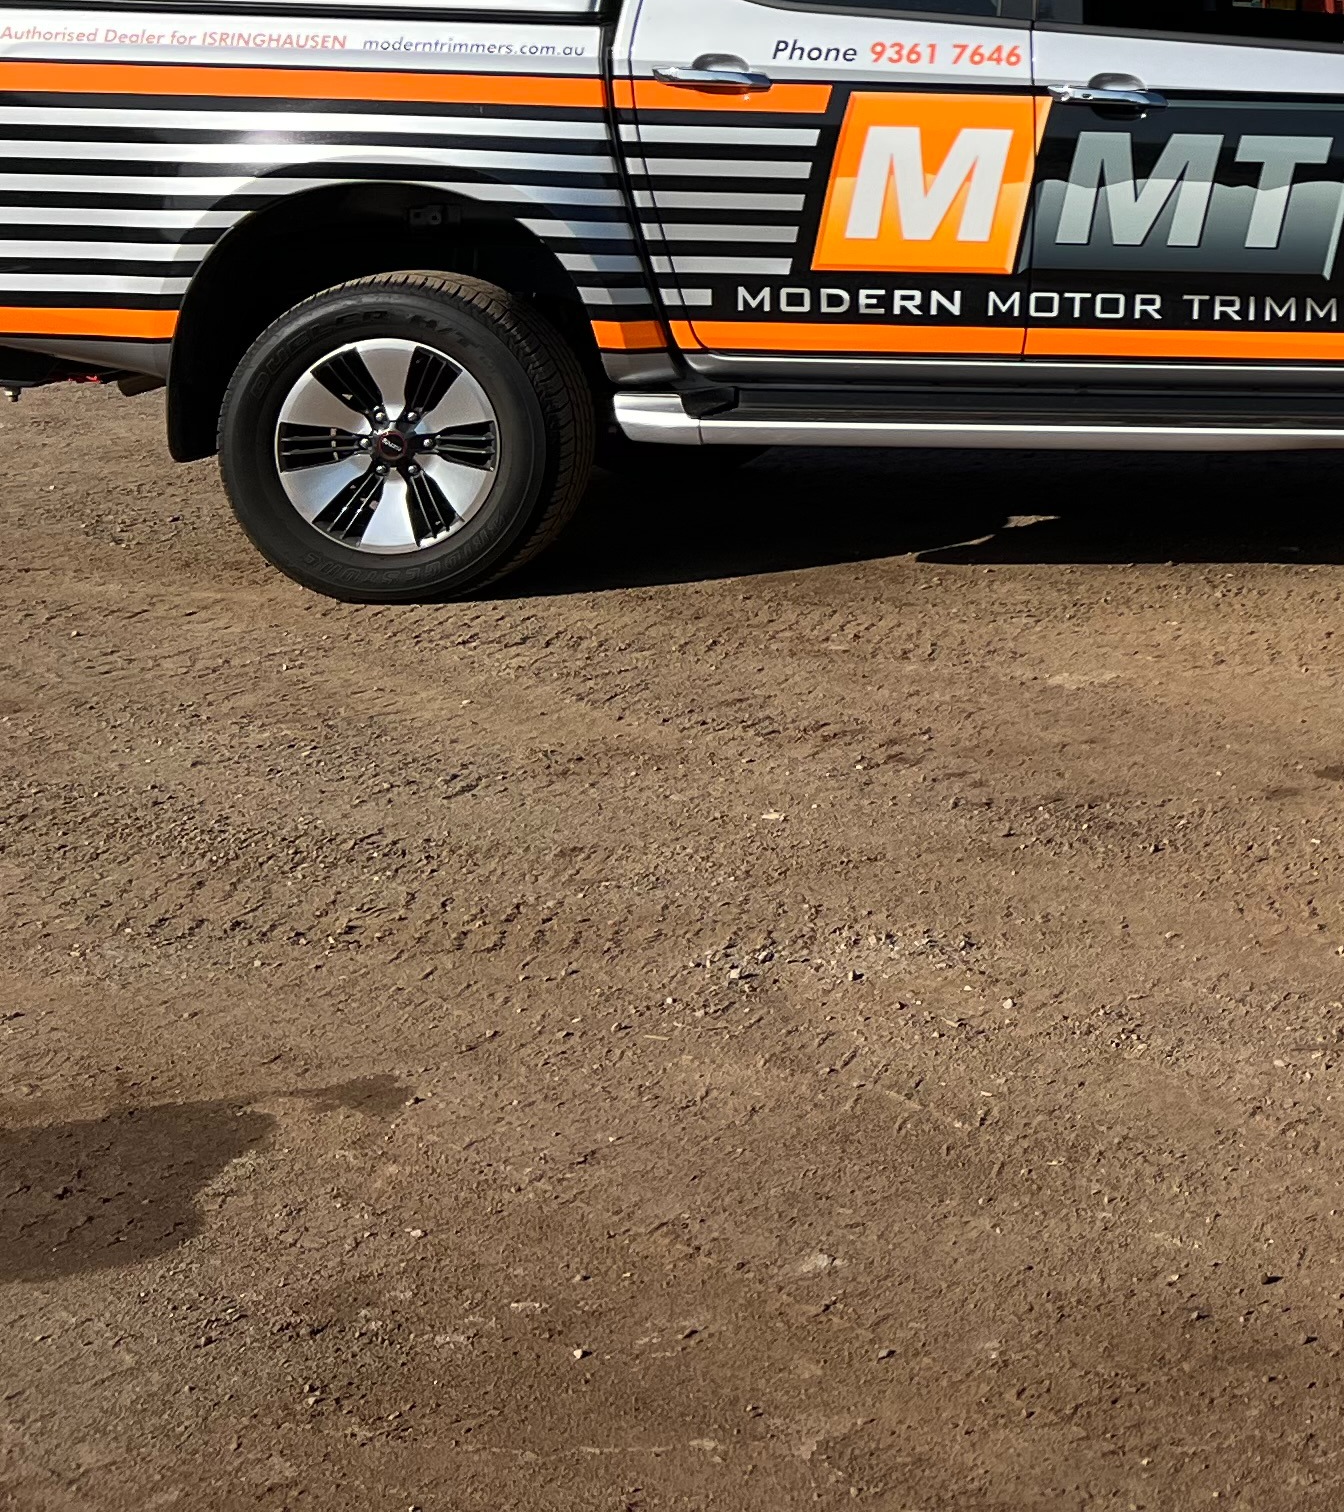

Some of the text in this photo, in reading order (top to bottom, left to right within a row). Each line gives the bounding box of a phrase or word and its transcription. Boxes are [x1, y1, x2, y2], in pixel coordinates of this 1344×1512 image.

[1, 25, 347, 50] Authorised Dealer for ISRINGHAUSEN
[362, 36, 586, 58] moderntrimmers.com.au
[771, 39, 1023, 67] Phone 9361 7646
[736, 285, 963, 316] MODERN
[987, 291, 1163, 320] MOTOR
